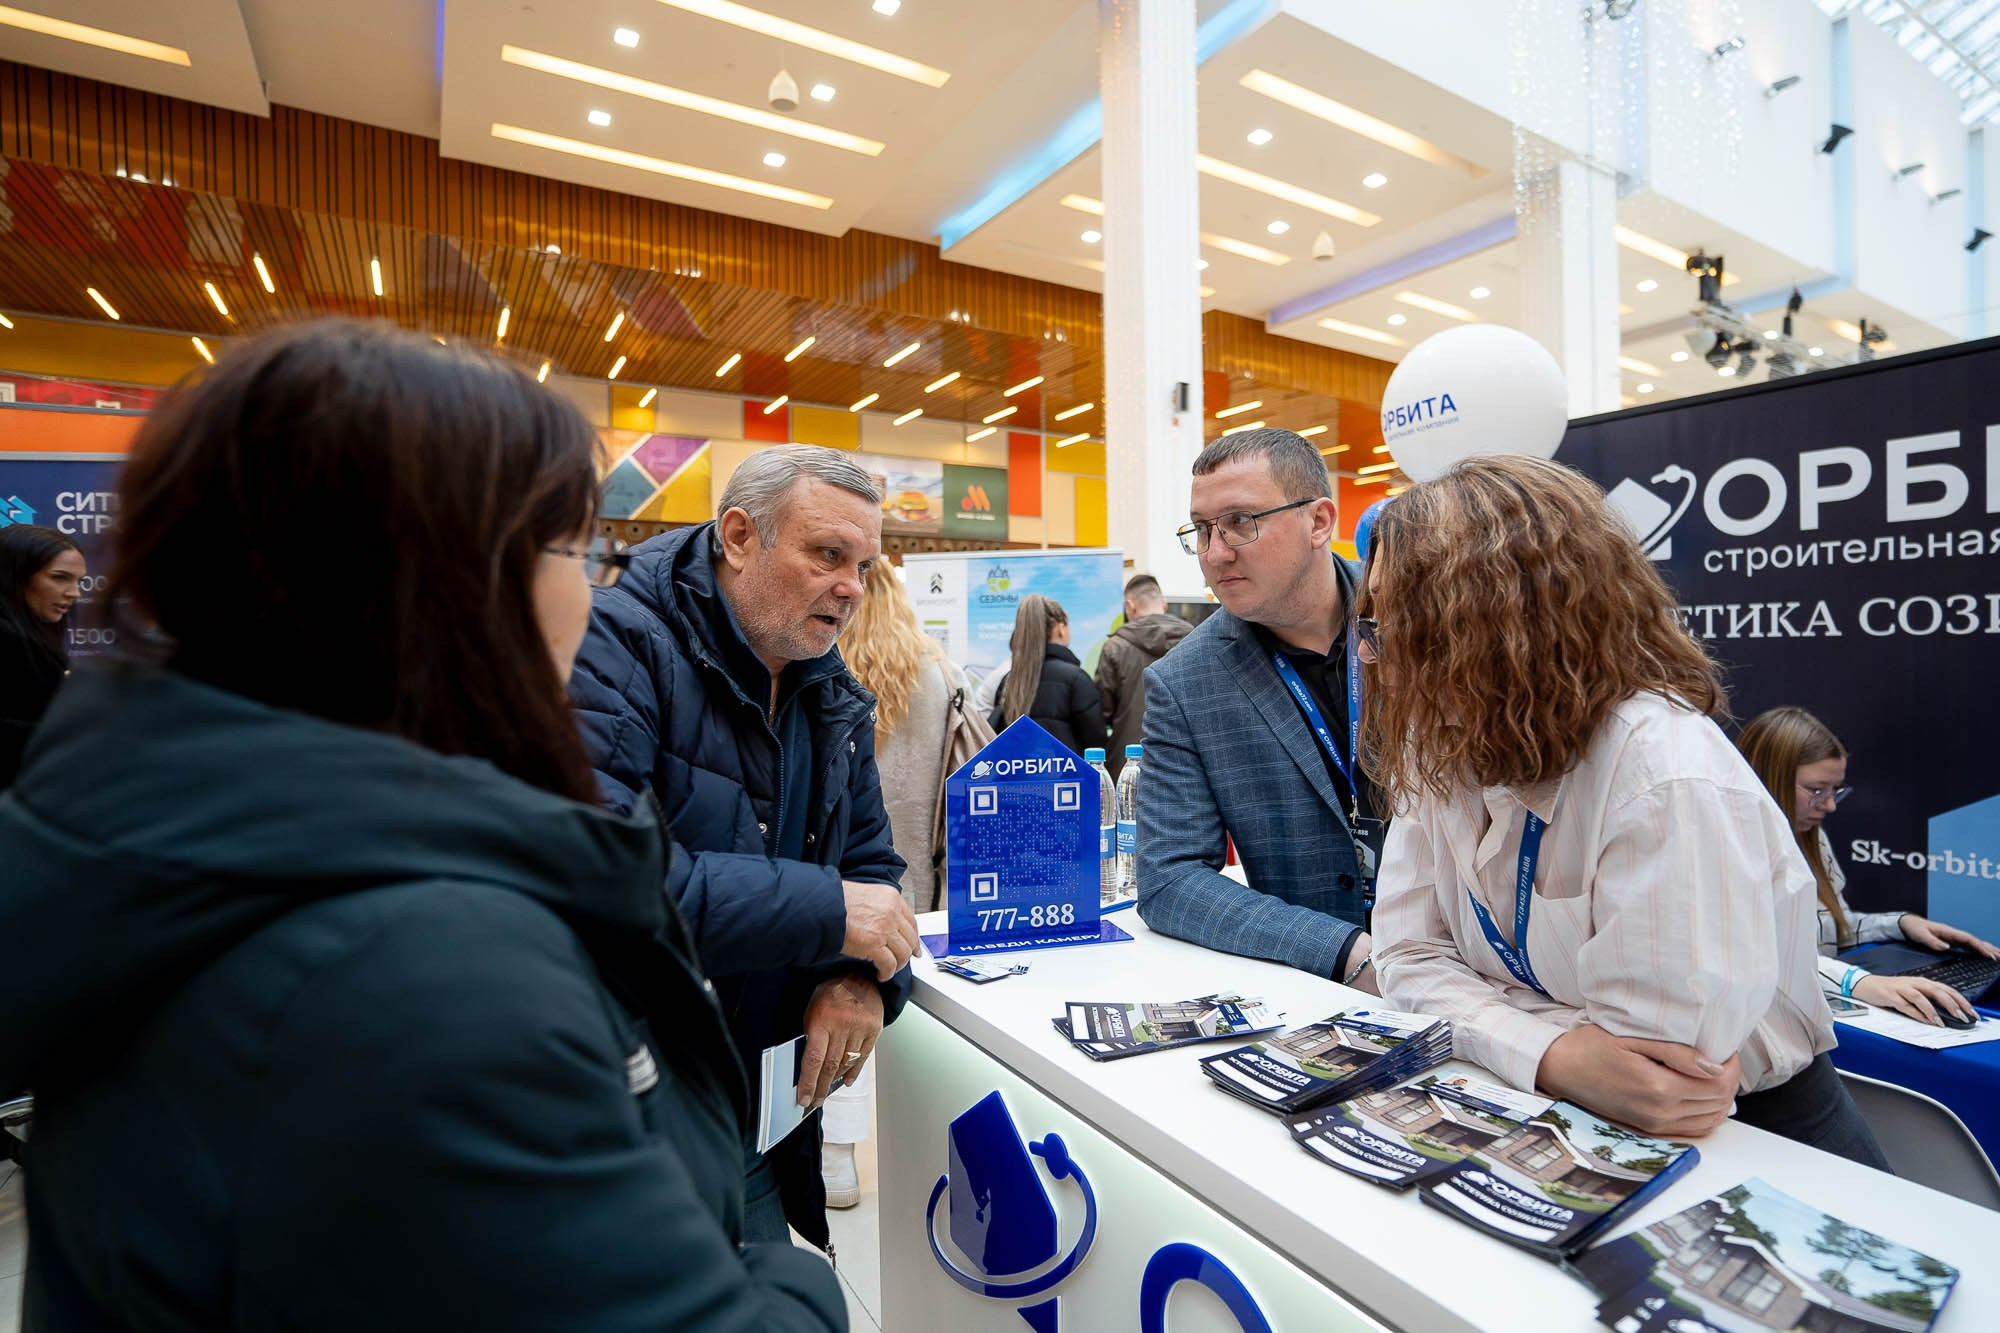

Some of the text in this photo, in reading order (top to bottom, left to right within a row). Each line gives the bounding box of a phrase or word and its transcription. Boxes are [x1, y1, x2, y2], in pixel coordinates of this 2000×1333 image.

[1704, 424, 2000, 536] ОРБ
[55, 491, 120, 512] СИТ
[56, 514, 117, 535] СТР
[67, 628, 116, 645] 1500
[996, 757, 1077, 776] ОРБИТА
[978, 903, 1075, 932] 777-888
[960, 933, 1101, 951] НАВЕДИ КАМЕРУ
[1260, 1060, 1312, 1086] ОРБИТА
[1360, 1135, 1427, 1166] ОРБИТА
[1491, 1182, 1575, 1221] ОРБИТА
